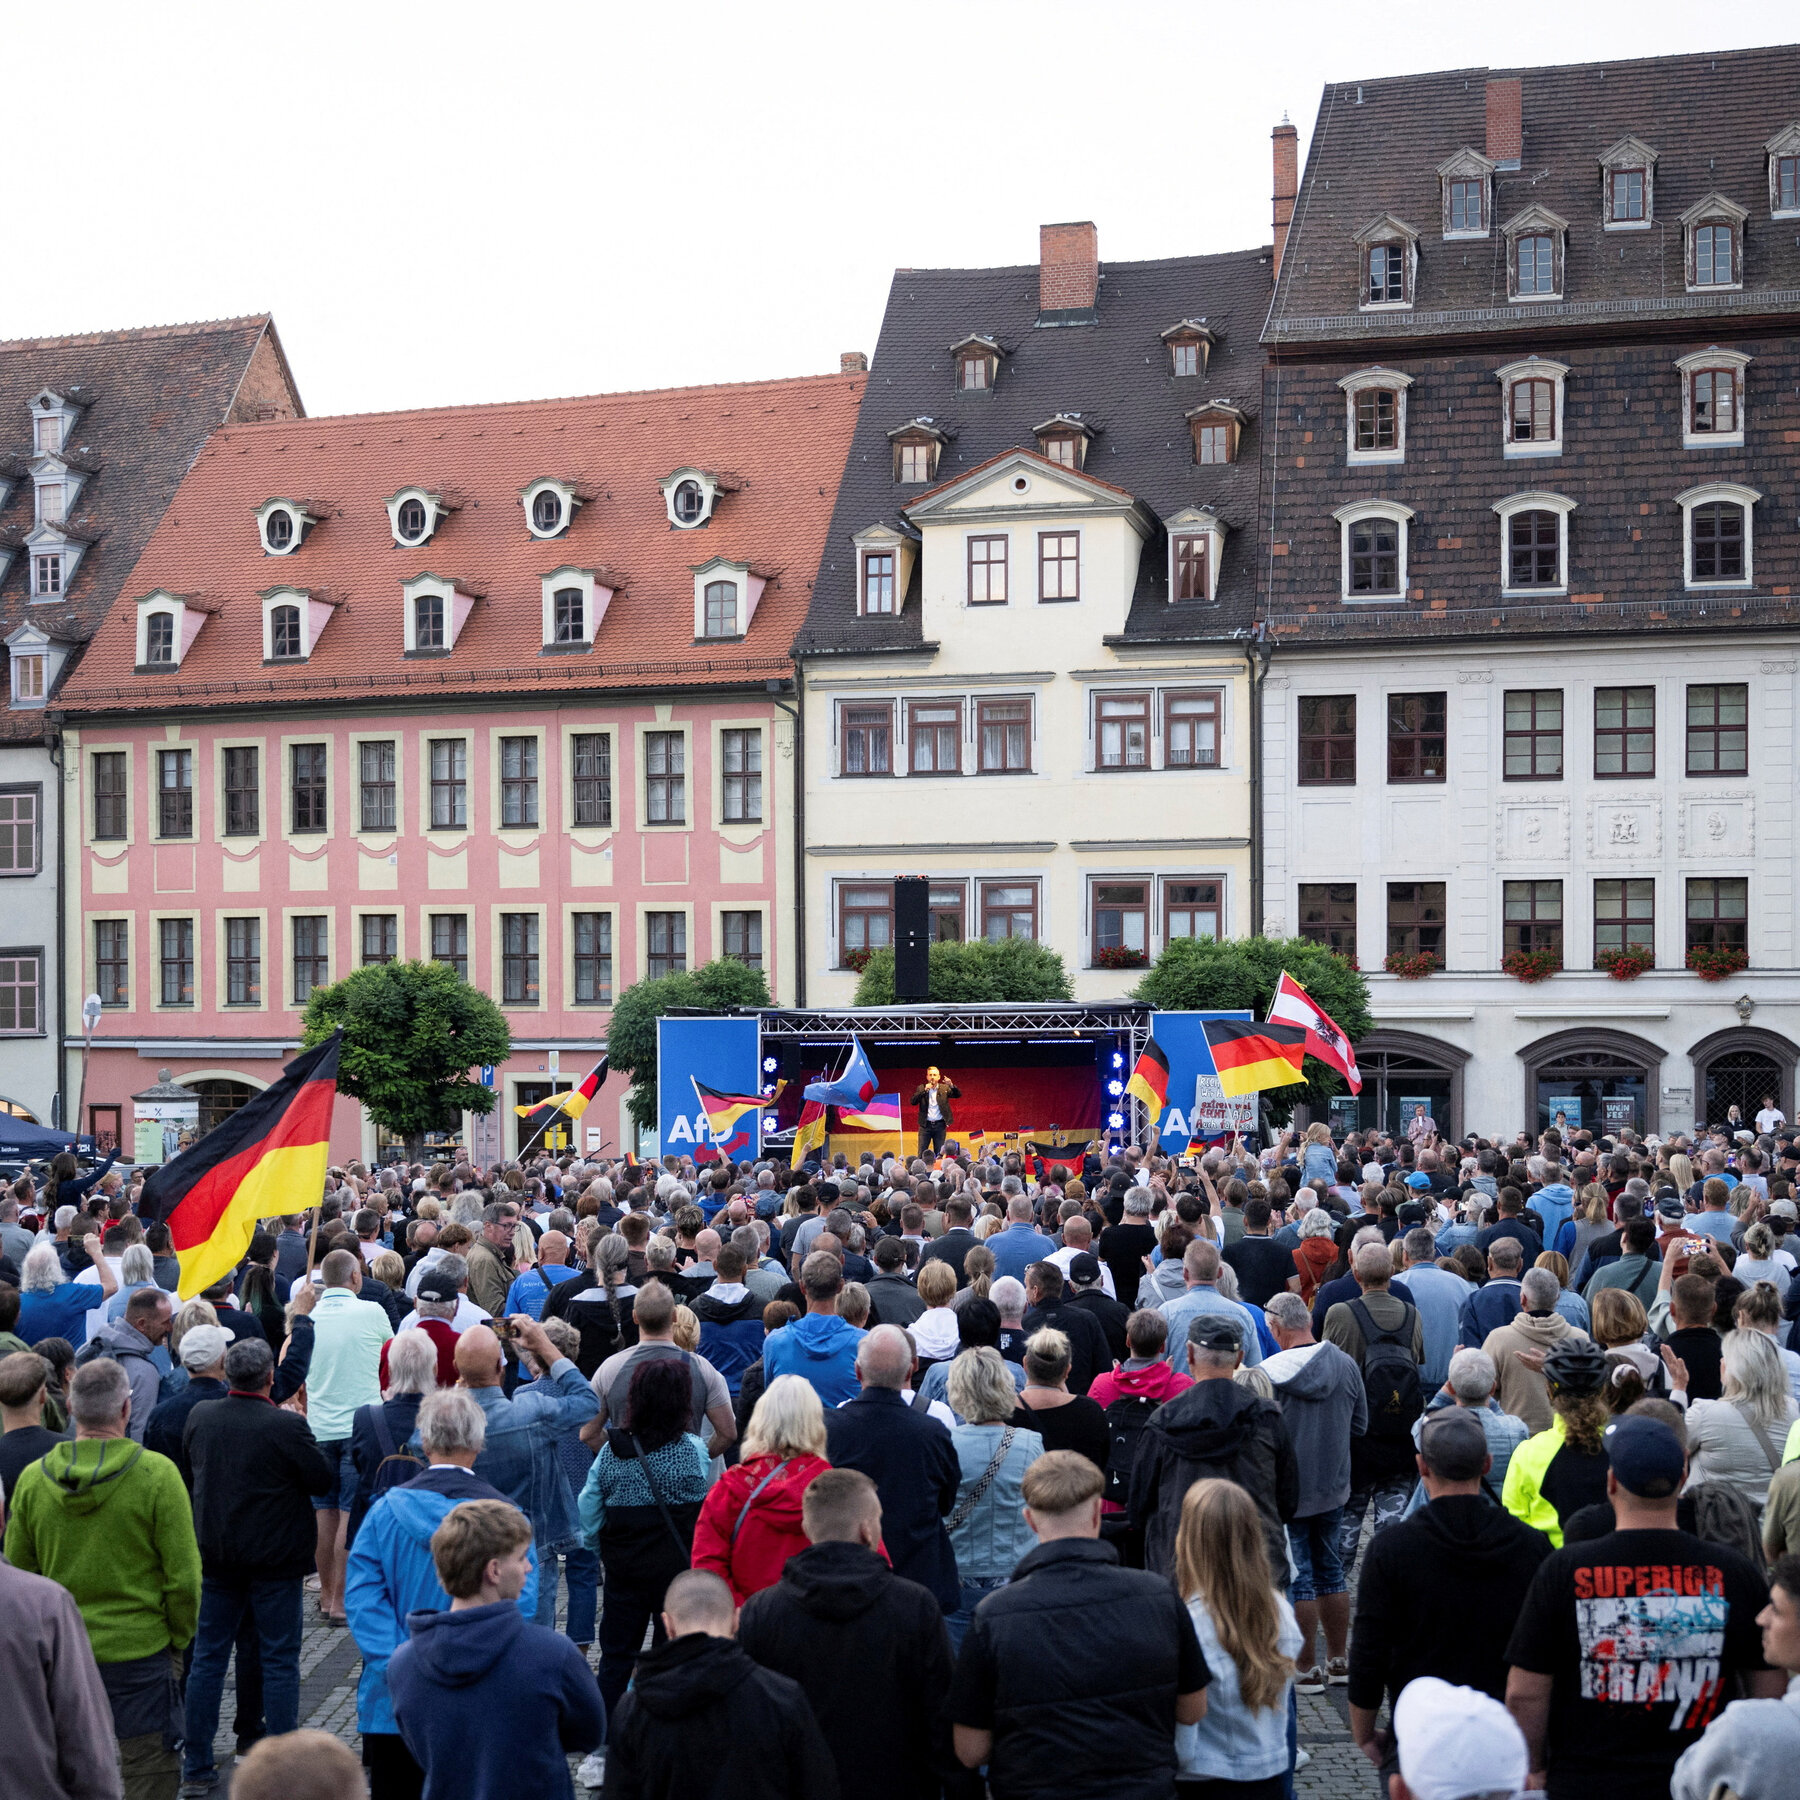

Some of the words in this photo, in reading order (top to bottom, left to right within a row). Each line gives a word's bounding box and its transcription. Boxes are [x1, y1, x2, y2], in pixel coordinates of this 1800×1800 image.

[484, 1064, 492, 1083] P
[1606, 1103, 1630, 1112] WEIN
[1162, 1106, 1224, 1136] Af
[1574, 1565, 1725, 1598] SUPERIOR
